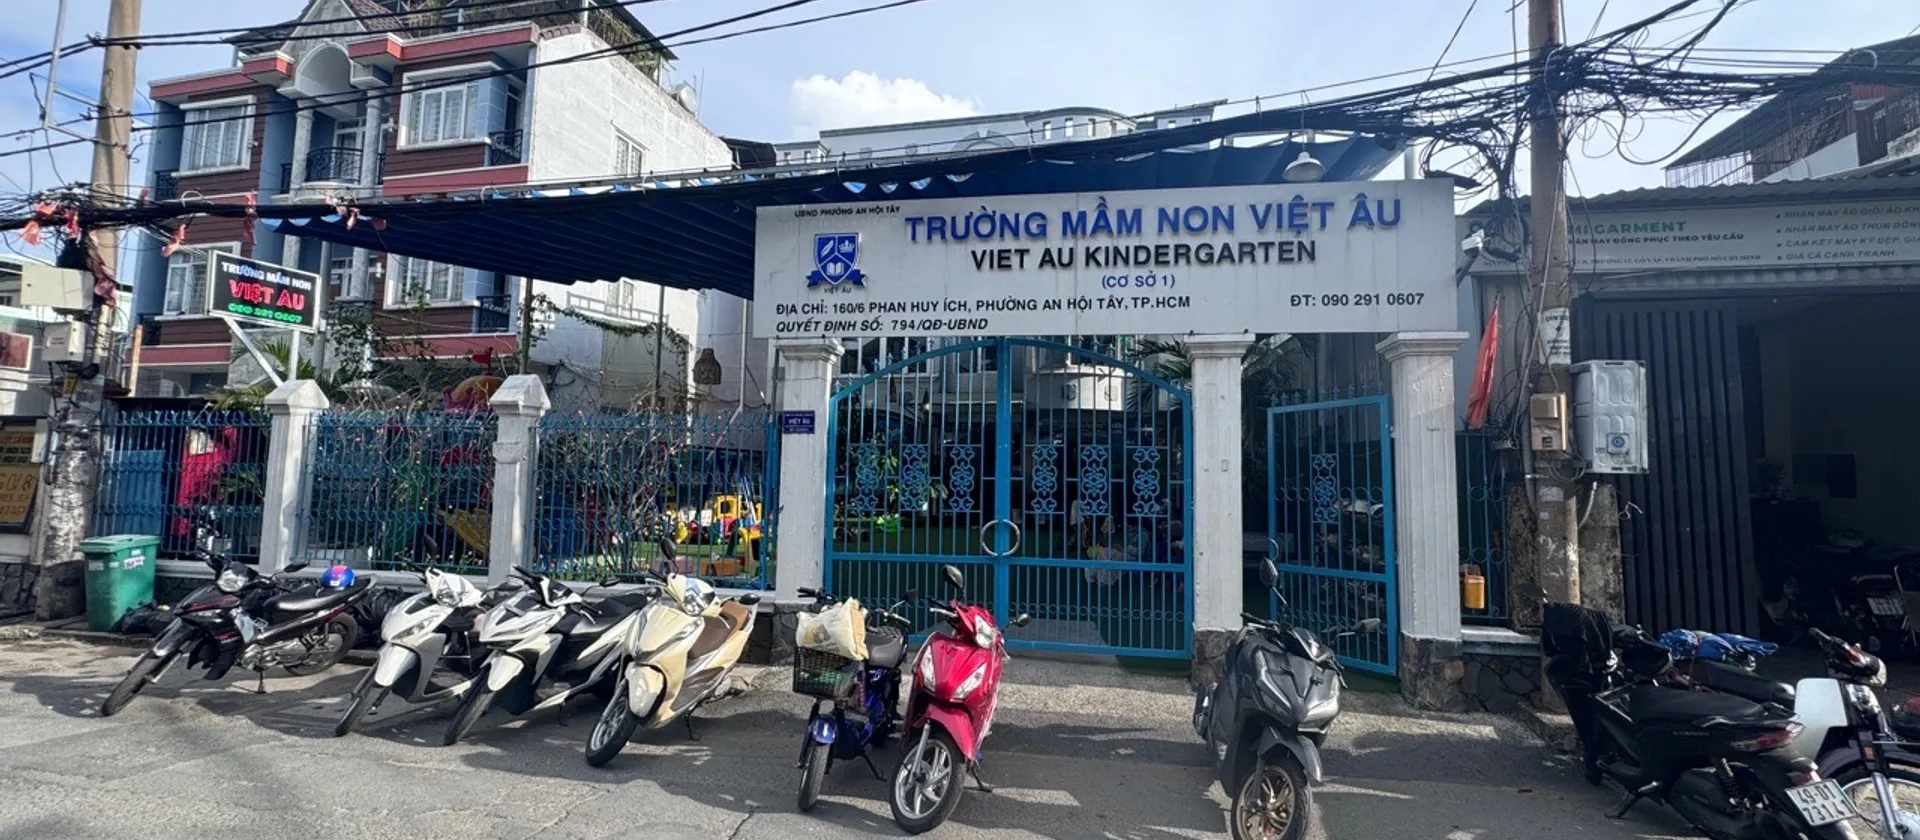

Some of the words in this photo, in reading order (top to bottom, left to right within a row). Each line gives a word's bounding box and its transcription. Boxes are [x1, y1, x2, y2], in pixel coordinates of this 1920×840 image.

[794, 209, 818, 218] UBND
[855, 207, 867, 215] AN
[868, 206, 884, 216] HỘI
[886, 204, 900, 214] TÂY
[904, 205, 1048, 241] TRƯỜNG
[1061, 196, 1143, 237] MẦM
[1157, 203, 1235, 233] NON
[1249, 194, 1335, 237] VIỆT
[1347, 192, 1401, 229] ÂU
[1593, 221, 1687, 234] GARMENT
[1700, 233, 1720, 241] YÊU
[971, 248, 1030, 269] VIET
[1038, 247, 1074, 269] AU
[1084, 240, 1317, 268] KINDERGARTEN
[292, 278, 312, 290] NON
[1101, 274, 1129, 289] (CƠ
[1134, 270, 1157, 288] SỞ
[1161, 274, 1176, 289] 1)
[229, 279, 274, 304] VIỆT
[1290, 294, 1316, 307] ĐT:
[1321, 293, 1349, 306] 090
[1354, 293, 1380, 306] 291
[1386, 292, 1425, 306] 0607
[776, 303, 798, 316] ĐỊA
[801, 299, 828, 315] CHỈ:
[832, 302, 865, 314] 160/6
[869, 301, 906, 313] PHAN
[910, 300, 939, 313] HUY
[943, 297, 972, 313] ÍCH,
[976, 295, 1037, 311] PHƯỜNG
[1042, 299, 1062, 310] AN
[1067, 297, 1092, 313] HỘI
[1096, 294, 1128, 310] TÂY,
[1131, 296, 1191, 308] TP.HCM
[775, 317, 821, 333] QUYẾT
[824, 320, 857, 334] ĐỊNH
[860, 315, 884, 332] SỐ:
[891, 318, 988, 332] 794/QĐ-UBND
